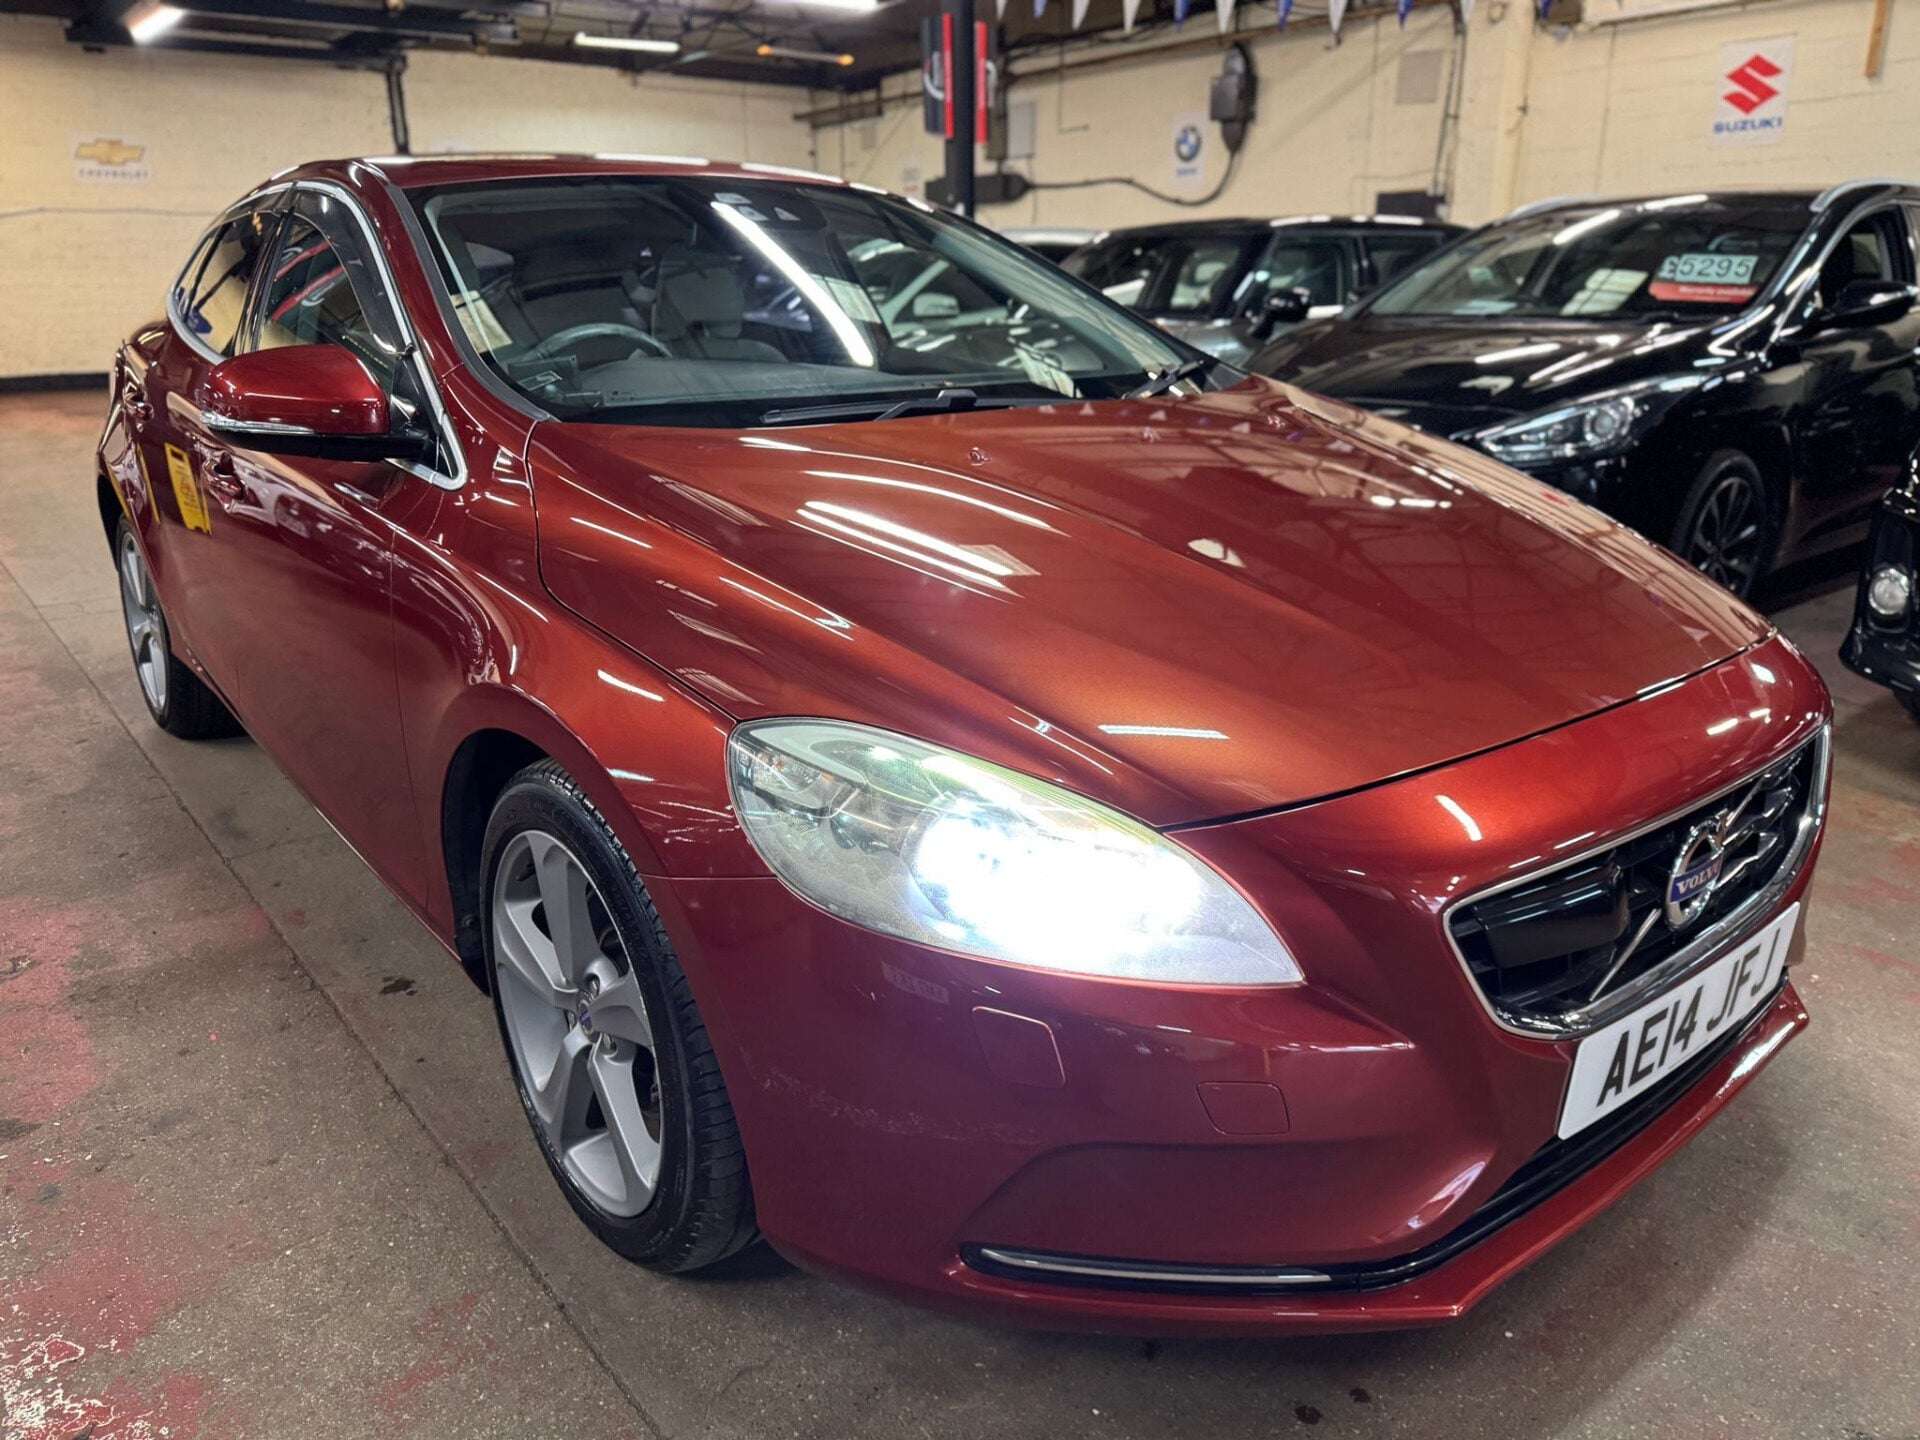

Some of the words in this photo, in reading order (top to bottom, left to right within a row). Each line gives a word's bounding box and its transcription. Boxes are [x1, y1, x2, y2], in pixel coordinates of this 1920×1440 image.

[1713, 116, 1783, 134] SUZUKI
[1658, 256, 1751, 280] £5295
[1596, 985, 1704, 1107] AE14
[1706, 928, 1781, 1032] JFJ
